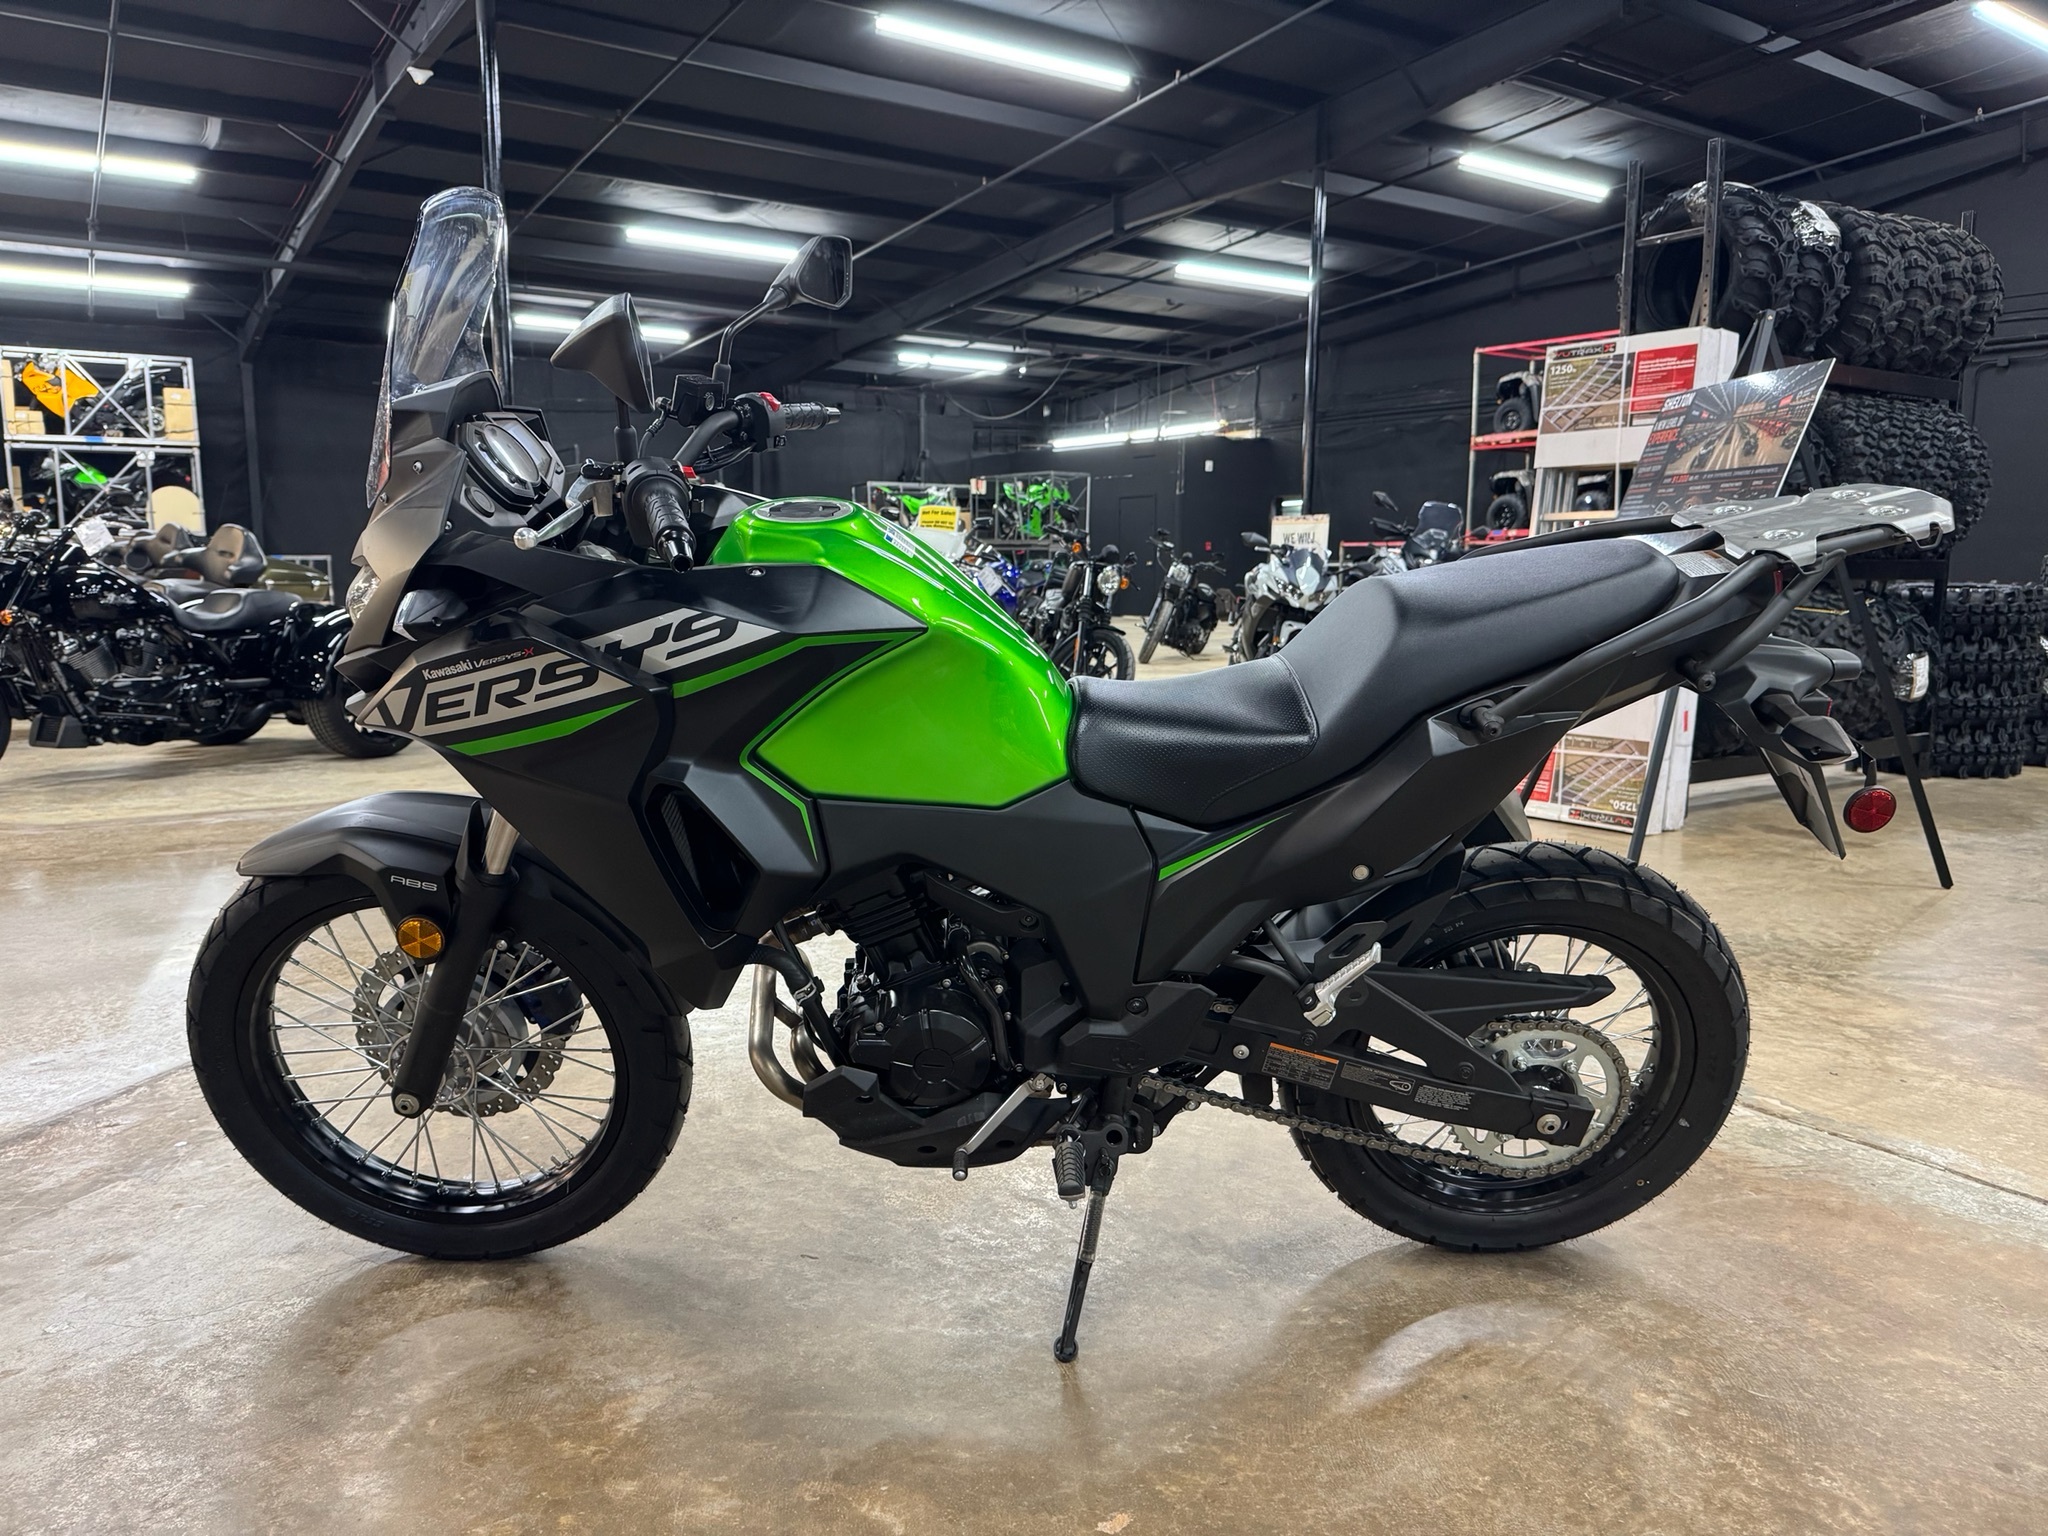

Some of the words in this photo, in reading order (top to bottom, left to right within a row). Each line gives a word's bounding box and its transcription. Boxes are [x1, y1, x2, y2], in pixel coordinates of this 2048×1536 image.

[1661, 391, 1696, 412] SHELTON
[1283, 532, 1296, 545] WE
[422, 659, 473, 680] Kawasaki
[474, 647, 534, 668] VERSYS-X
[390, 875, 437, 891] ABS
